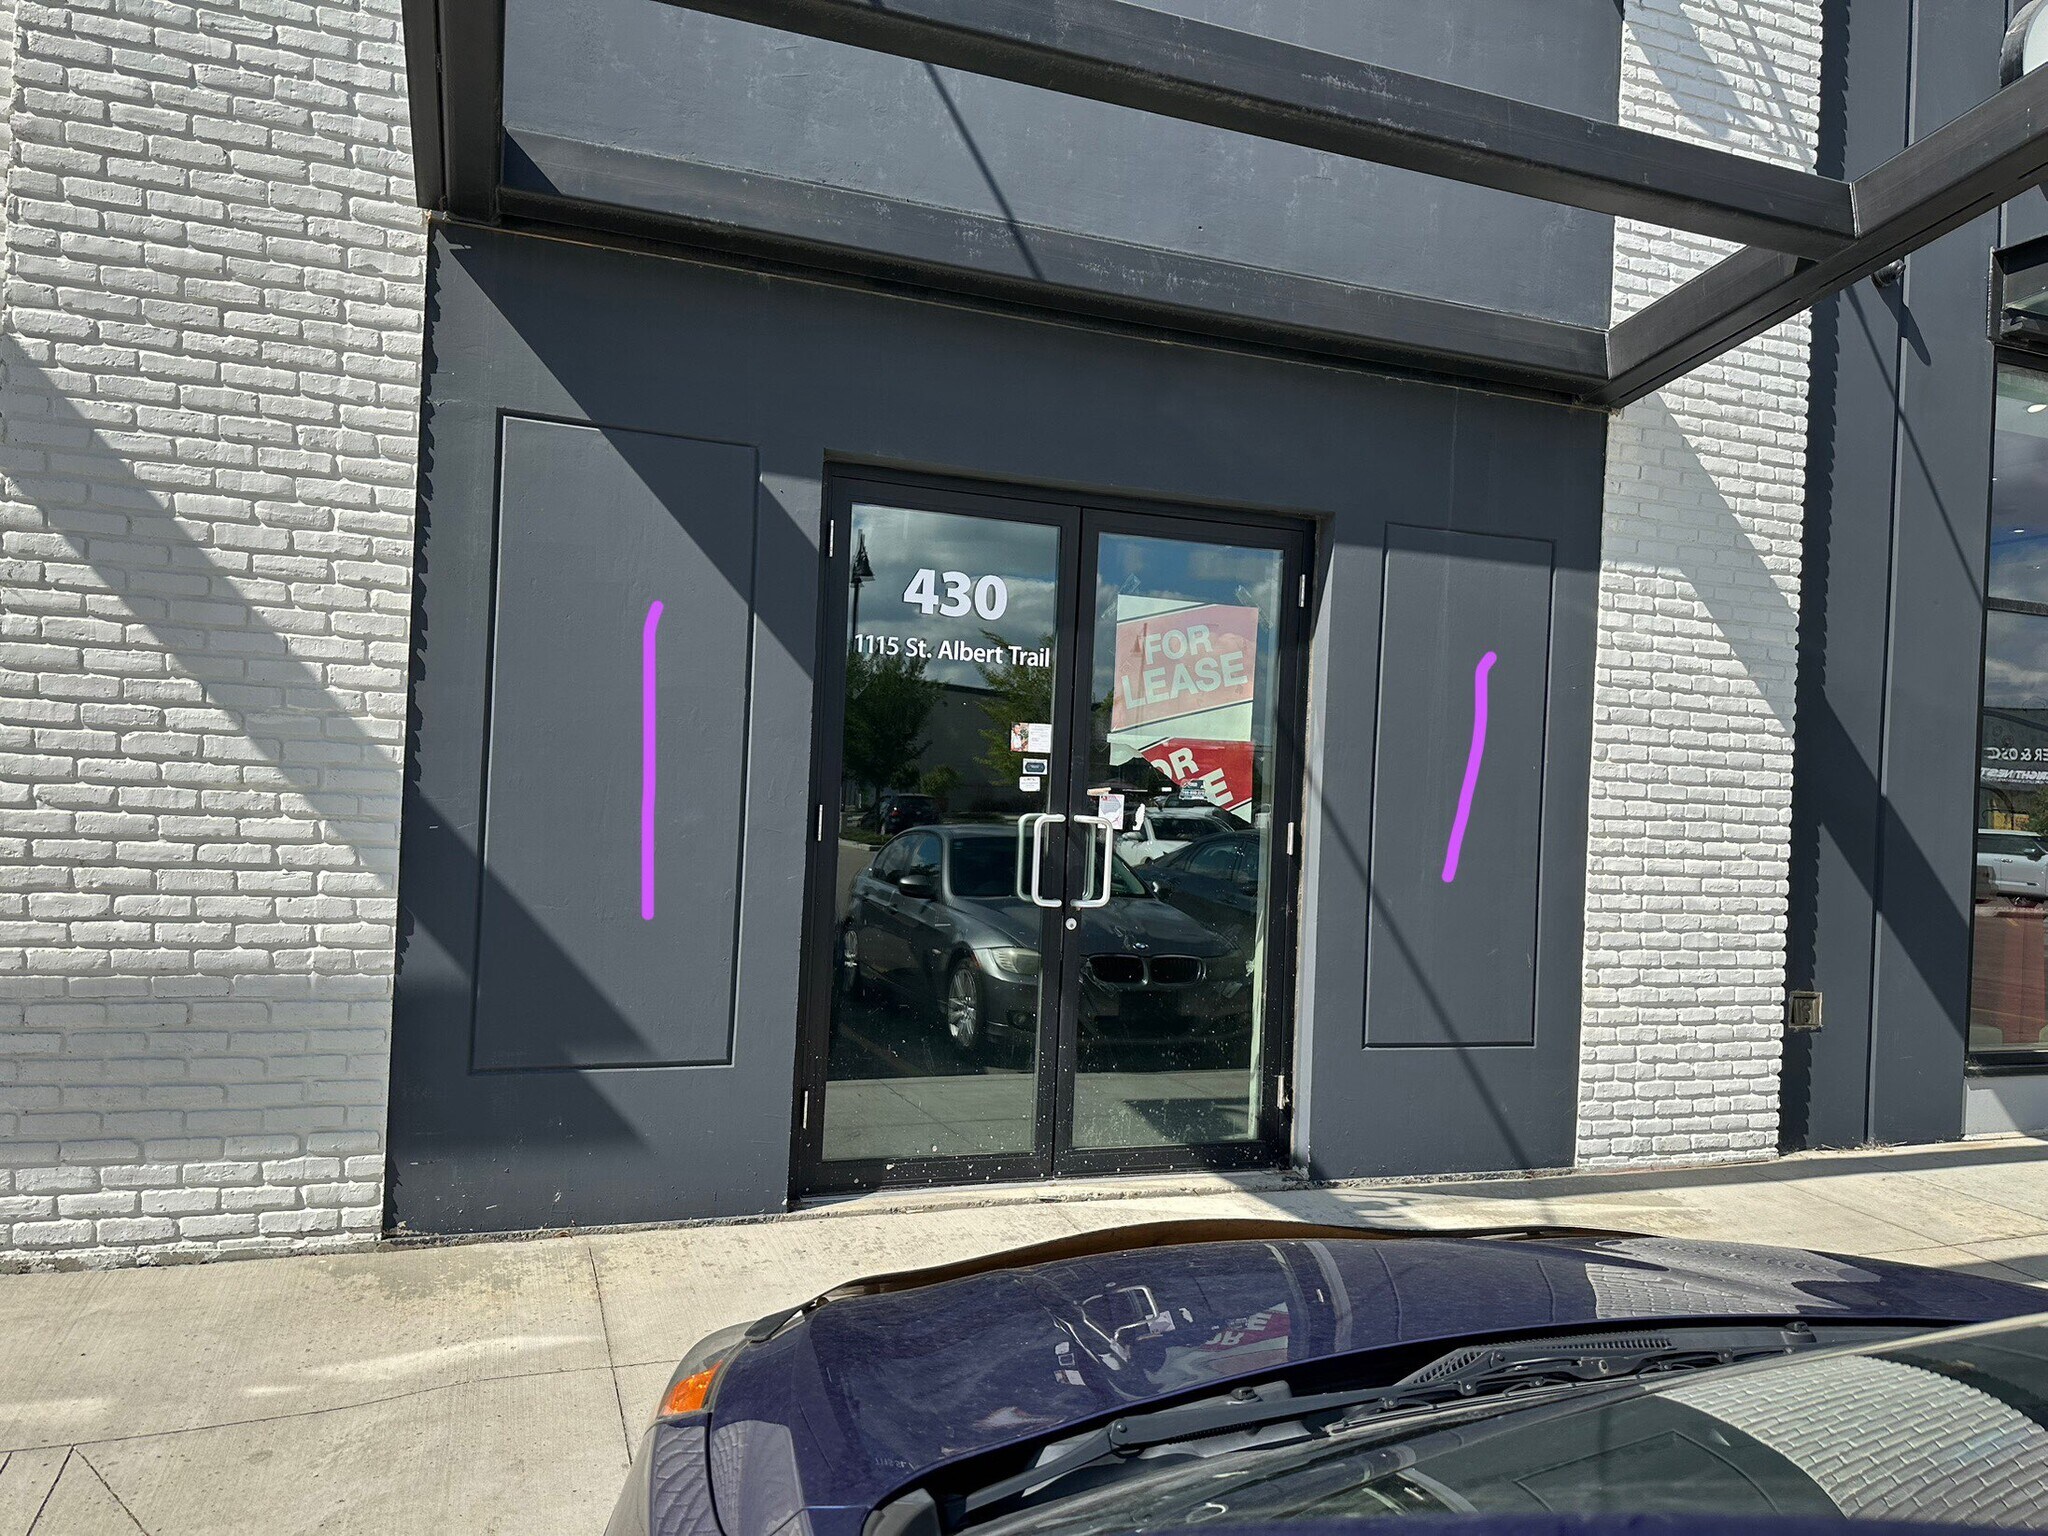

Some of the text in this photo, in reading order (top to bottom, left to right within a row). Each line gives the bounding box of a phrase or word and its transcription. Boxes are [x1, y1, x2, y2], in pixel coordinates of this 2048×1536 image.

[902, 568, 1008, 621] 430
[854, 633, 1050, 668] 1115 St. Albert Trail
[1143, 624, 1213, 665] FOR
[1121, 651, 1249, 710] LEASE
